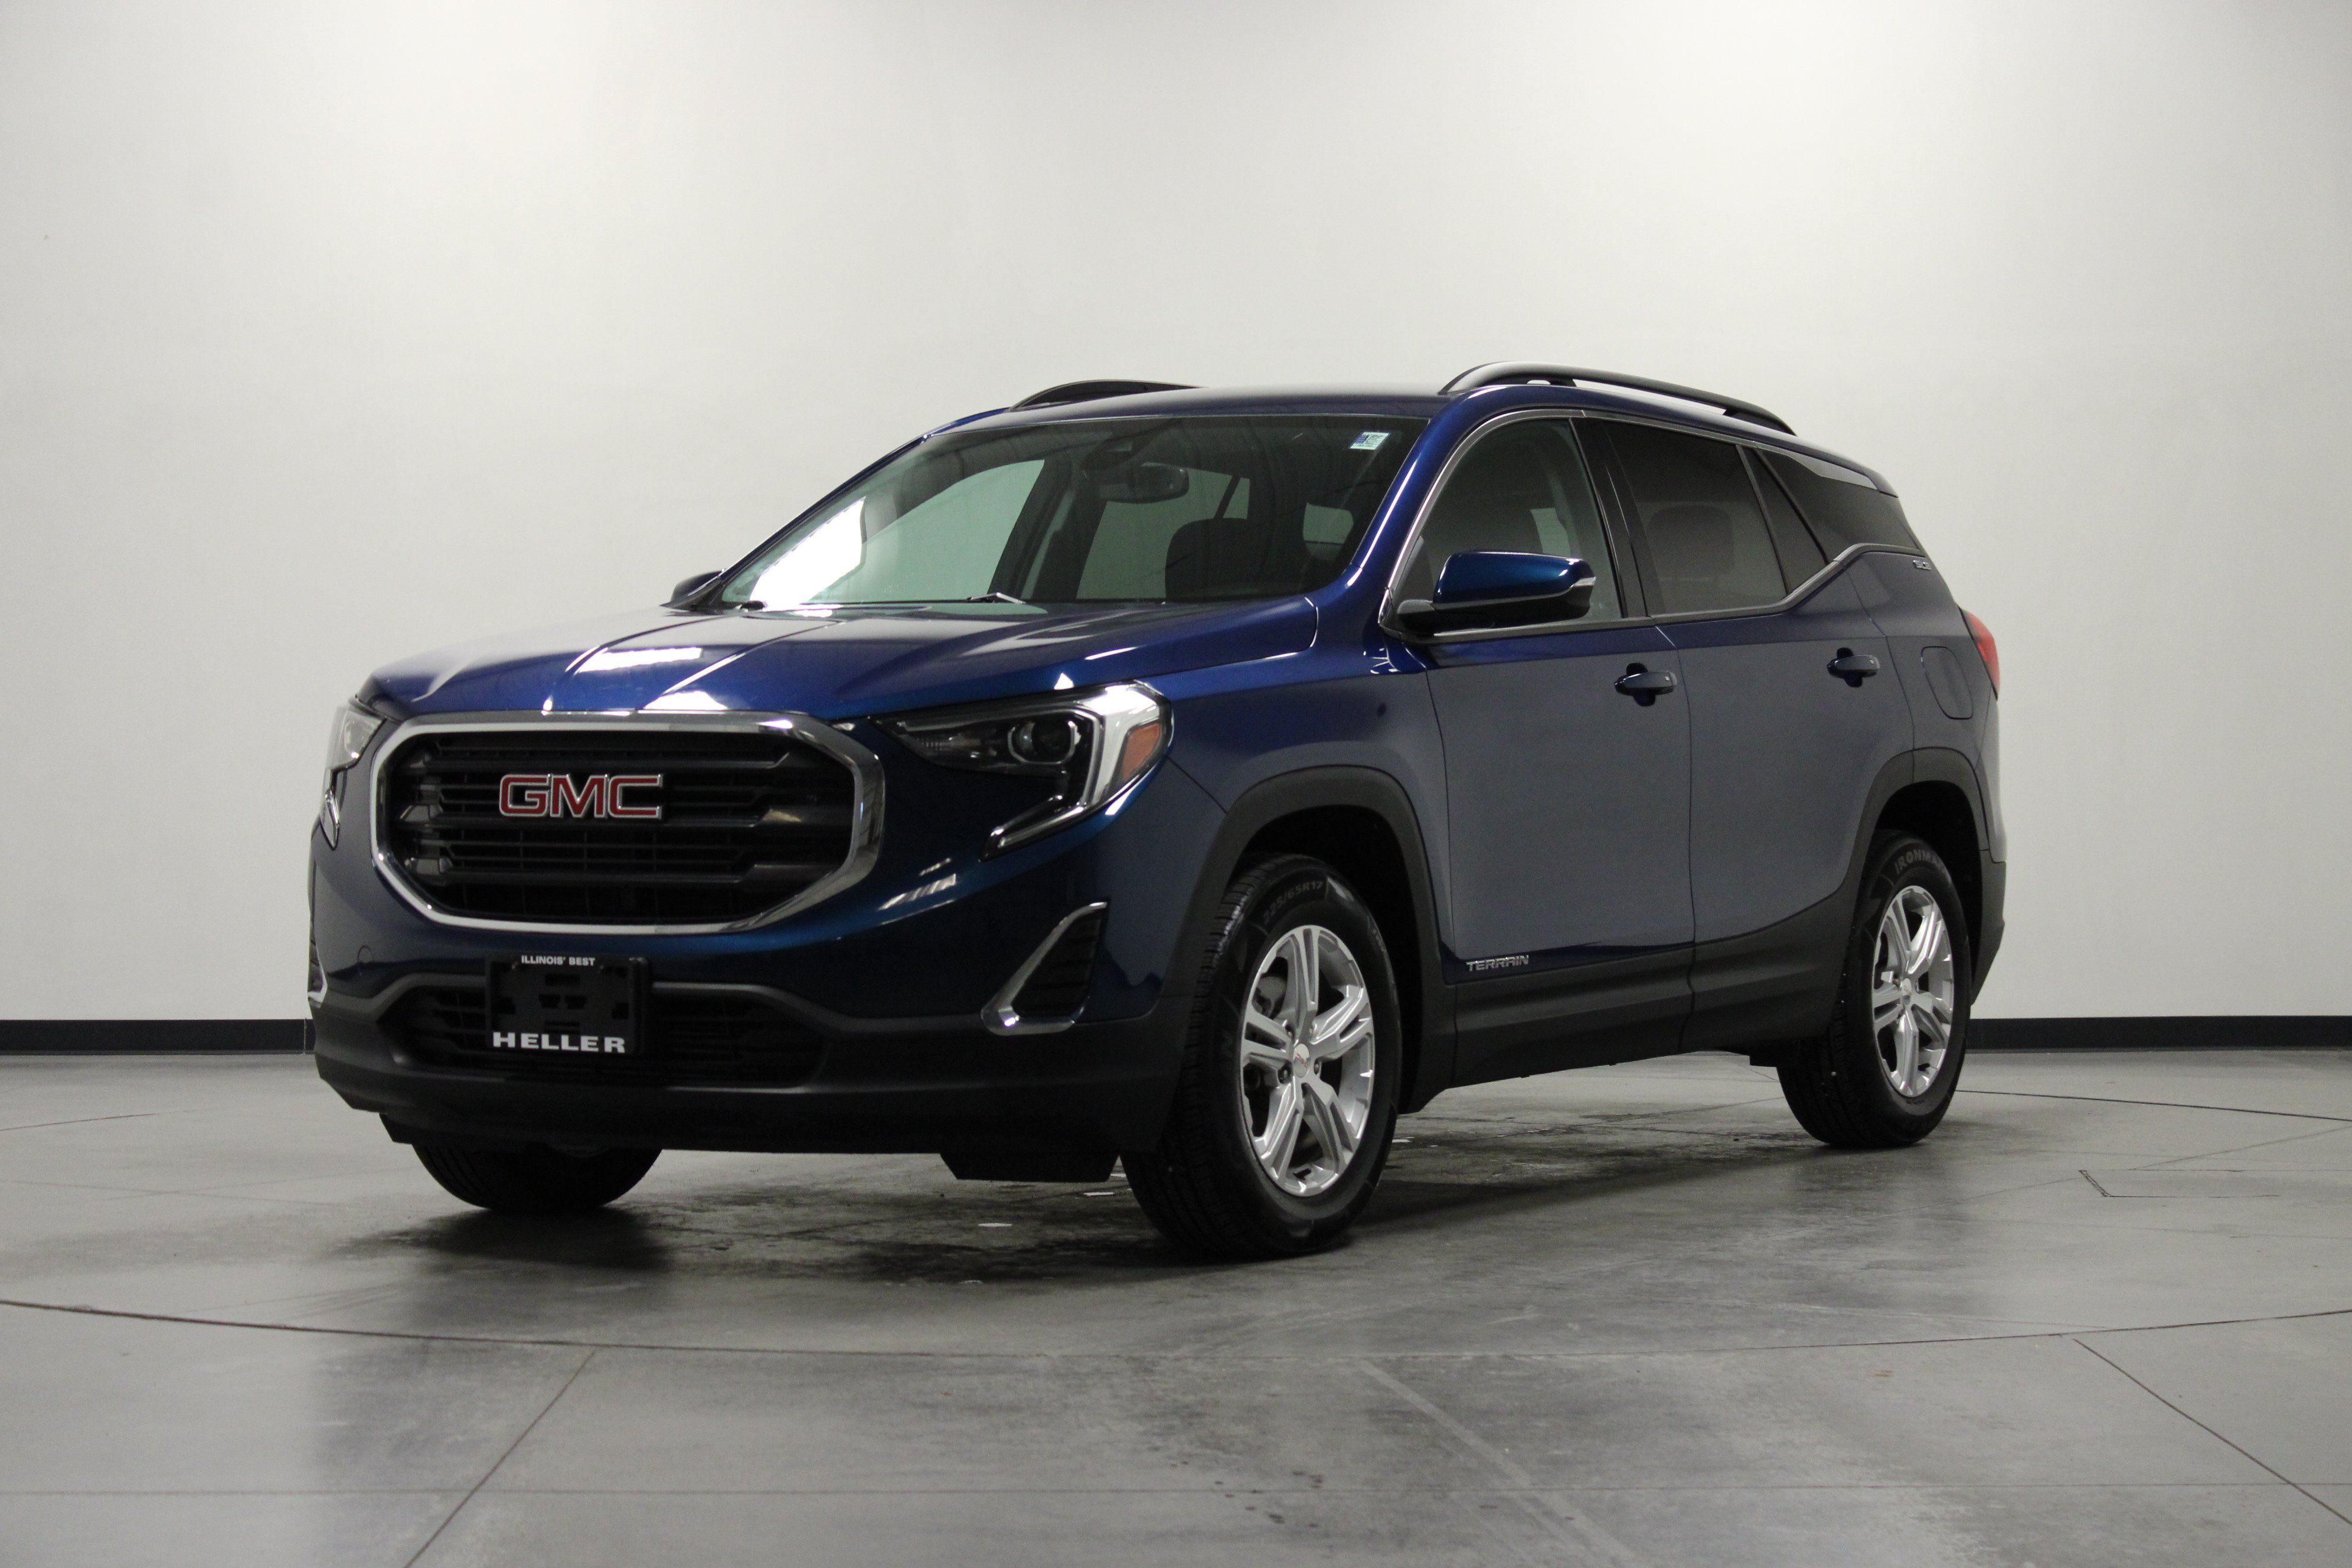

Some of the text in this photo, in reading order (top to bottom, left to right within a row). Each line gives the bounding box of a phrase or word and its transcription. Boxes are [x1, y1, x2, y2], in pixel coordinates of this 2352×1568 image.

[499, 774, 662, 818] GMC
[1894, 849, 1945, 875] IRONMA
[521, 955, 595, 966] ILLINOIS' BEST
[1465, 954, 1529, 972] TERRAIN
[493, 1031, 625, 1053] HELLER
